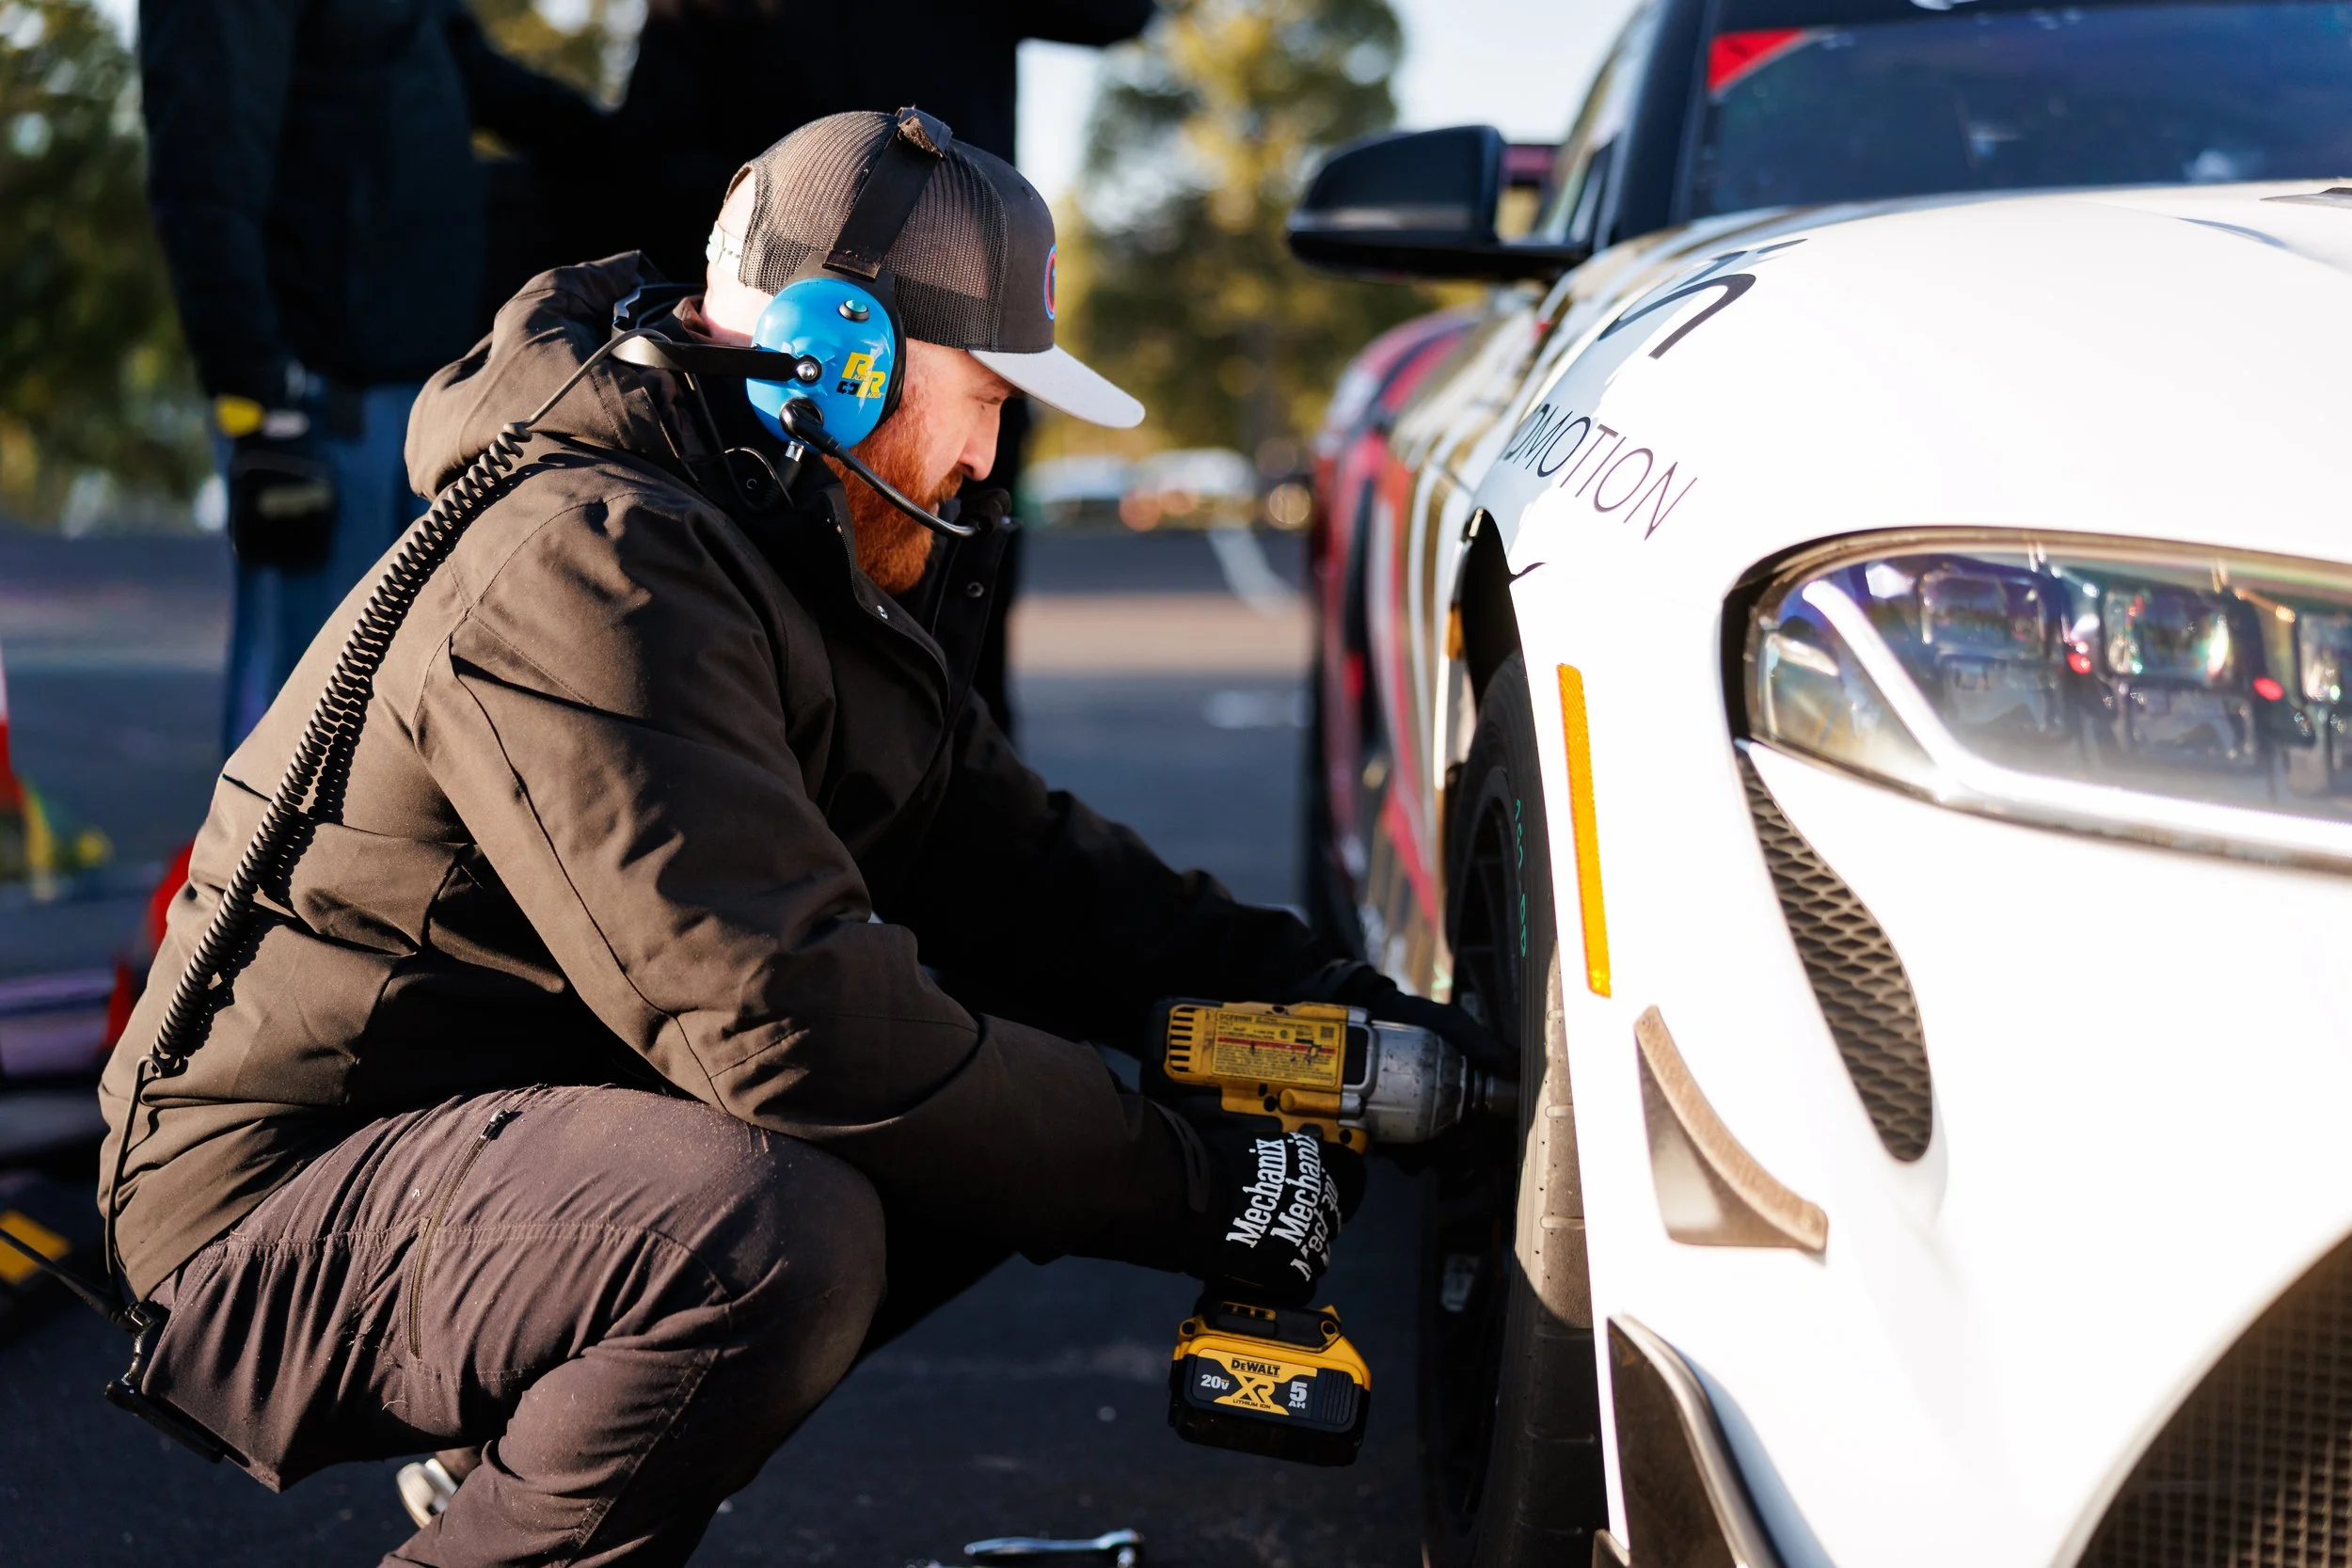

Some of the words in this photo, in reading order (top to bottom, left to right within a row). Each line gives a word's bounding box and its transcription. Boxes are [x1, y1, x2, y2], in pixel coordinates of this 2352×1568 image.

[1226, 1138, 1287, 1248] Mechanix
[1270, 1132, 1322, 1247] Mechanix
[1231, 1374, 1276, 1403] XR
[1232, 1399, 1258, 1407] LITHIUM
